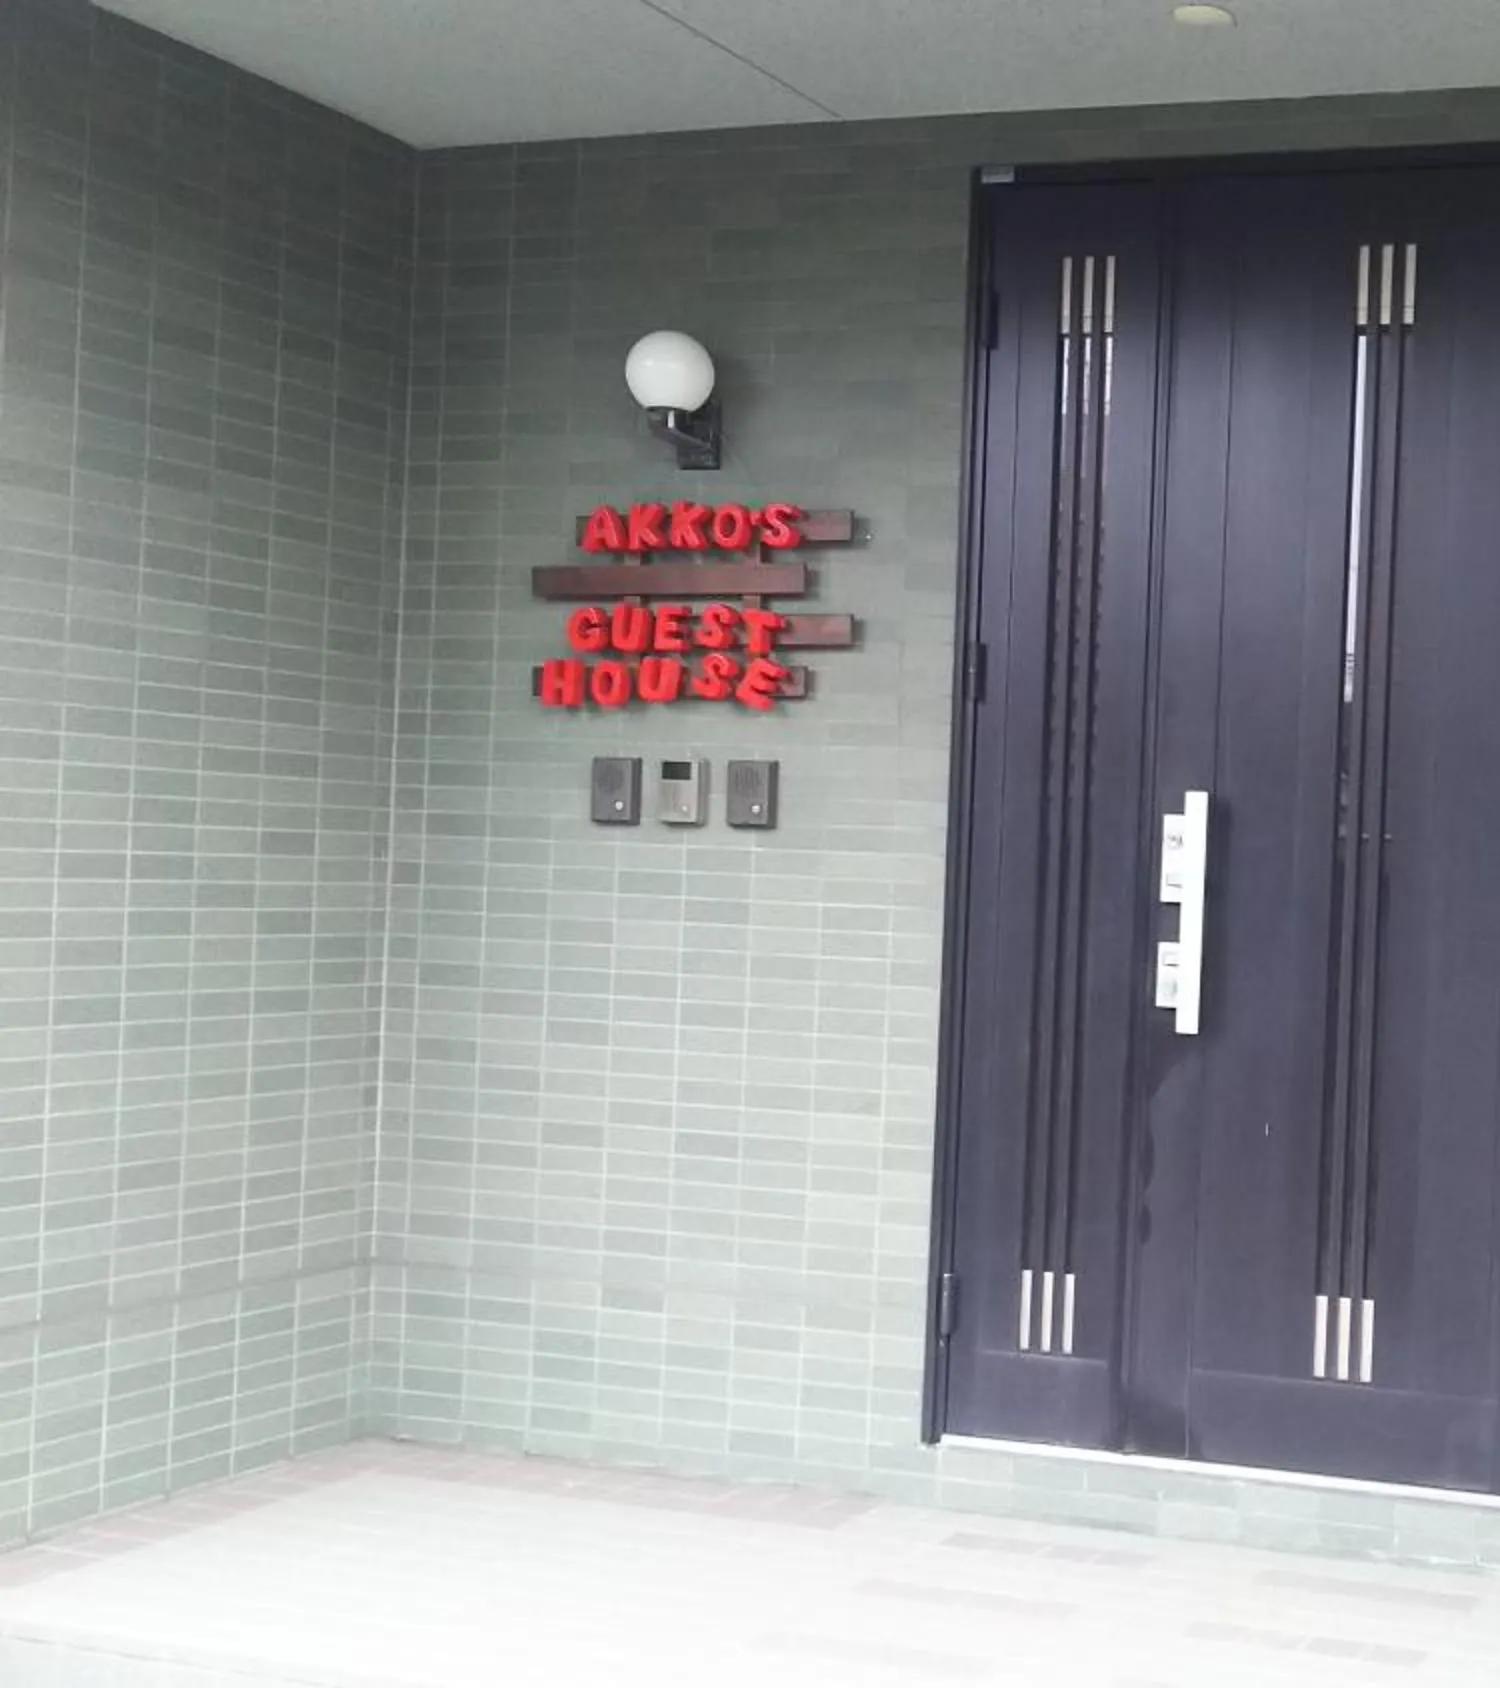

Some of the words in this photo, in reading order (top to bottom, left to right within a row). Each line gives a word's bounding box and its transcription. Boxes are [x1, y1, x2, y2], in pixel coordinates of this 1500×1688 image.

[581, 501, 802, 554] AKKO'S
[567, 603, 786, 655] GUEST
[539, 653, 788, 711] HOUSE
